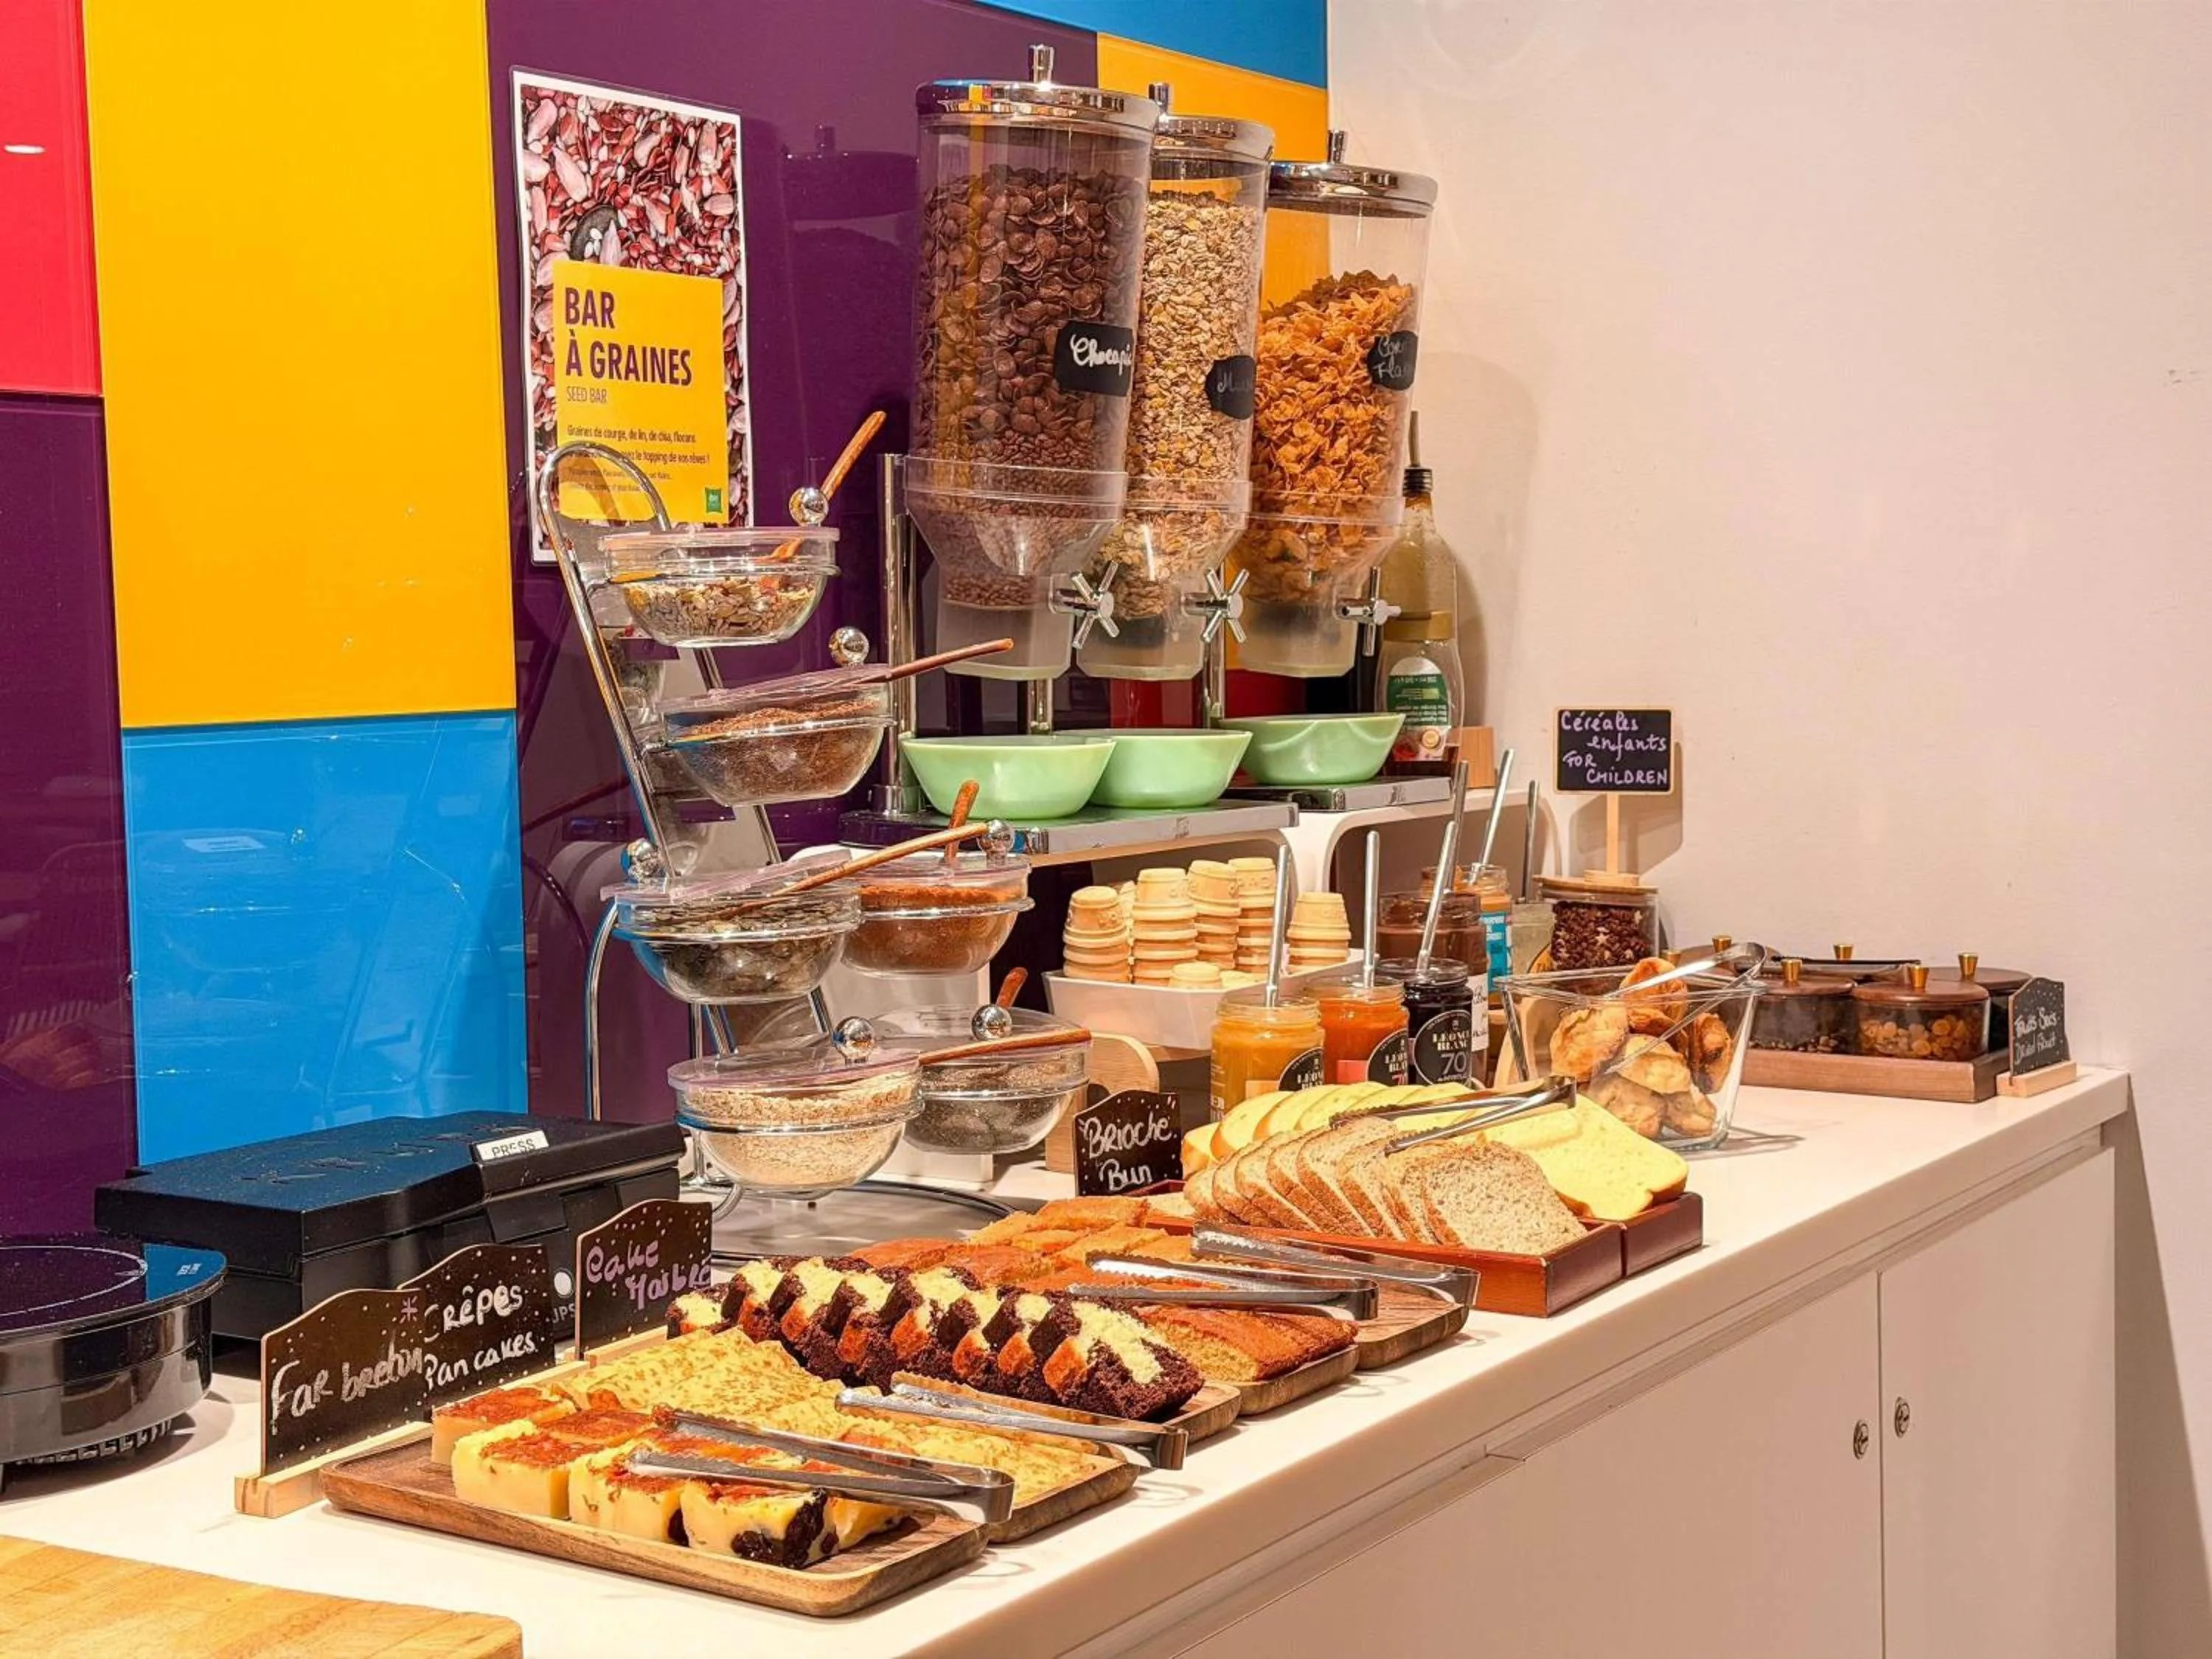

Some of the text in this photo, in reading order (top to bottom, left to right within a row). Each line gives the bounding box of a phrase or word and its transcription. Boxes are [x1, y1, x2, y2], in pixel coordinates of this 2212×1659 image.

[566, 287, 615, 329] BAR
[566, 328, 692, 386] À GRAINES
[566, 386, 608, 404] SEED BAR
[567, 424, 592, 437] Graines
[643, 451, 667, 465] topping
[1561, 710, 1639, 731] Céréales
[1586, 732, 1667, 762] enfants
[1562, 750, 1597, 768] FOR
[1084, 1110, 1172, 1159] Brioche
[491, 1138, 535, 1157] PRESS
[1098, 1158, 1152, 1192] Bun
